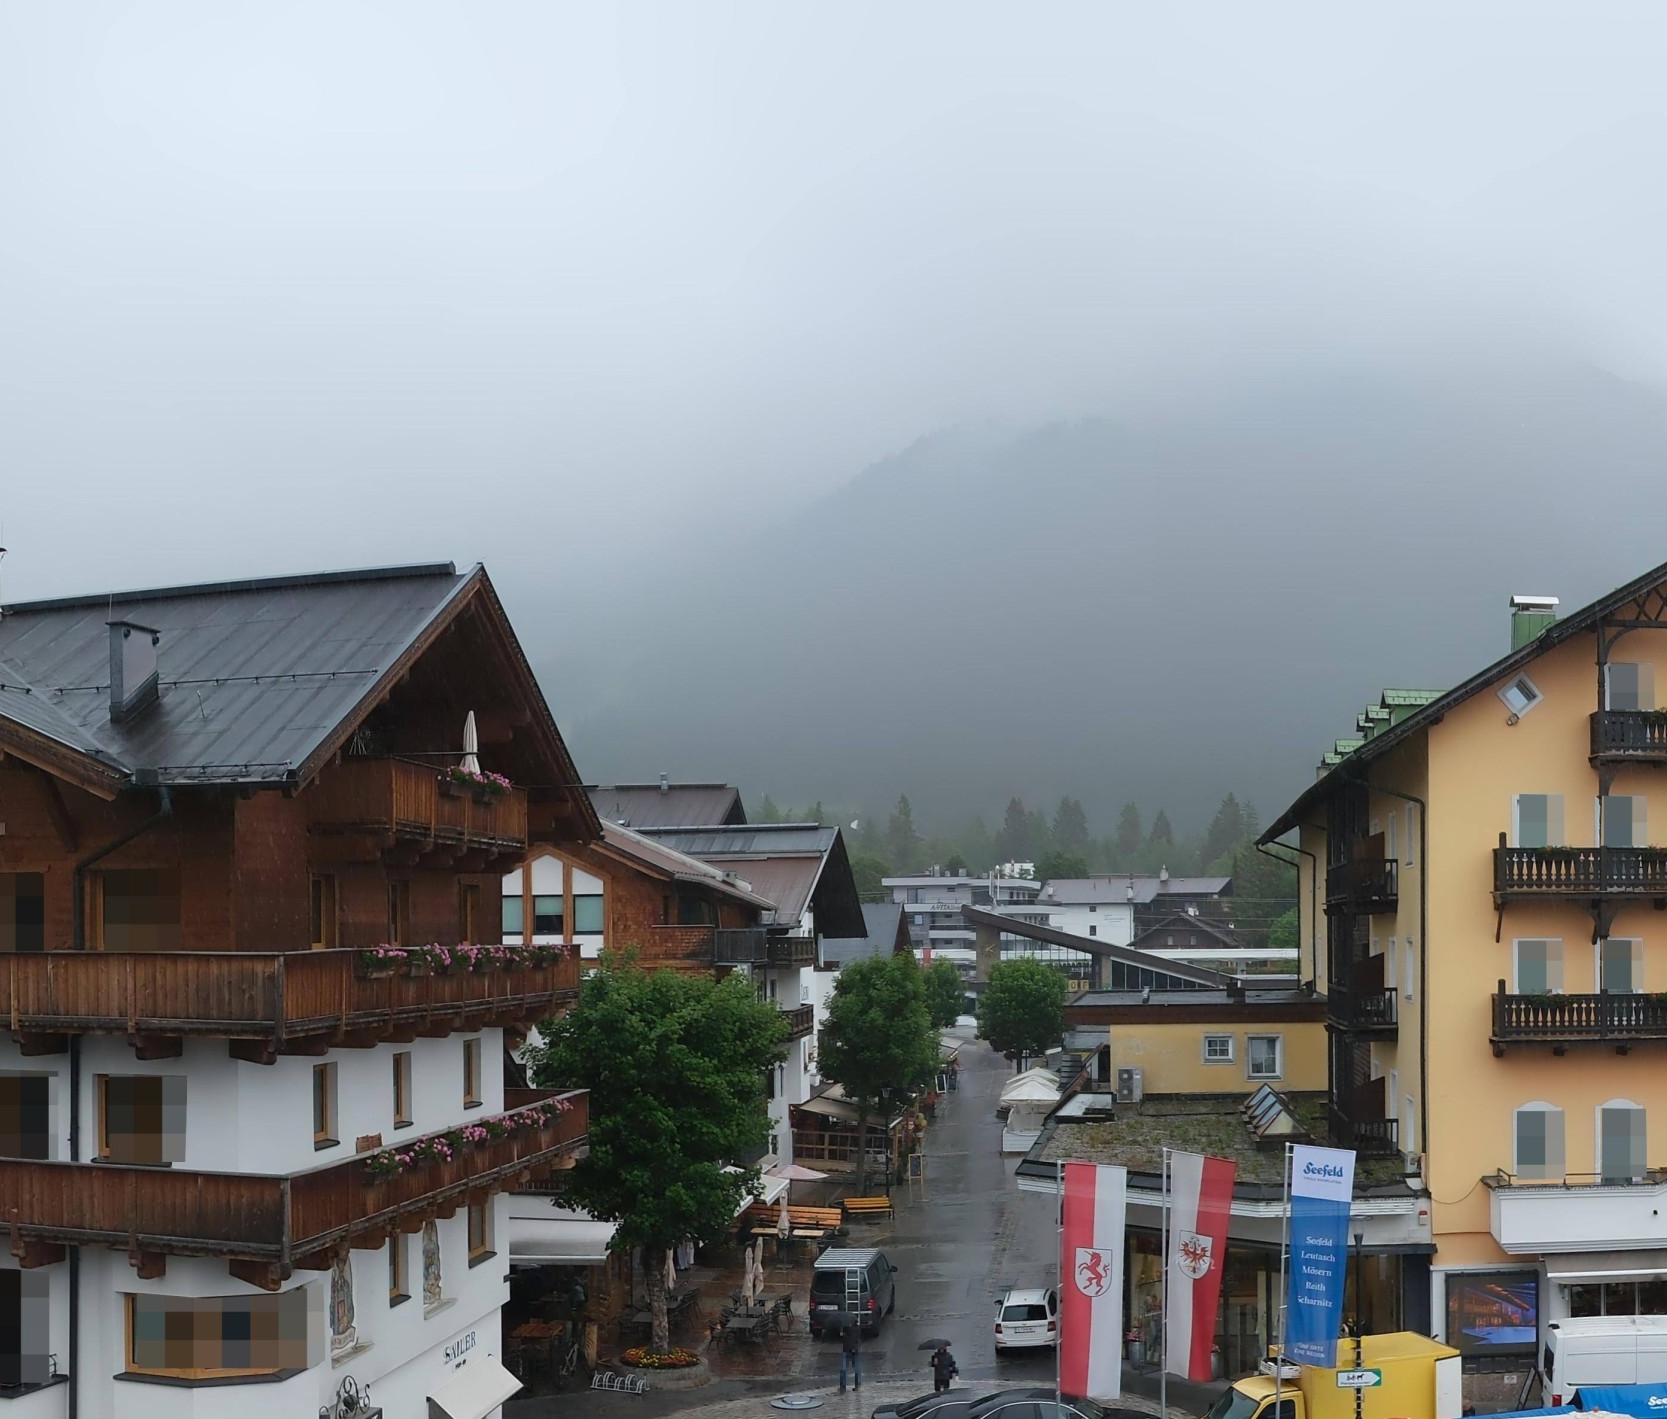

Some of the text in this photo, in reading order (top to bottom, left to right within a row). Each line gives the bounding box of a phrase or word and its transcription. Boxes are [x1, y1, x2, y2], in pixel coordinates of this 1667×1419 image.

[1303, 1162, 1343, 1178] Seefeld
[1306, 1236, 1333, 1247] Seefeld
[1301, 1251, 1336, 1262] Leutasch
[1302, 1265, 1332, 1277] Mösern
[1305, 1281, 1326, 1292] Reith
